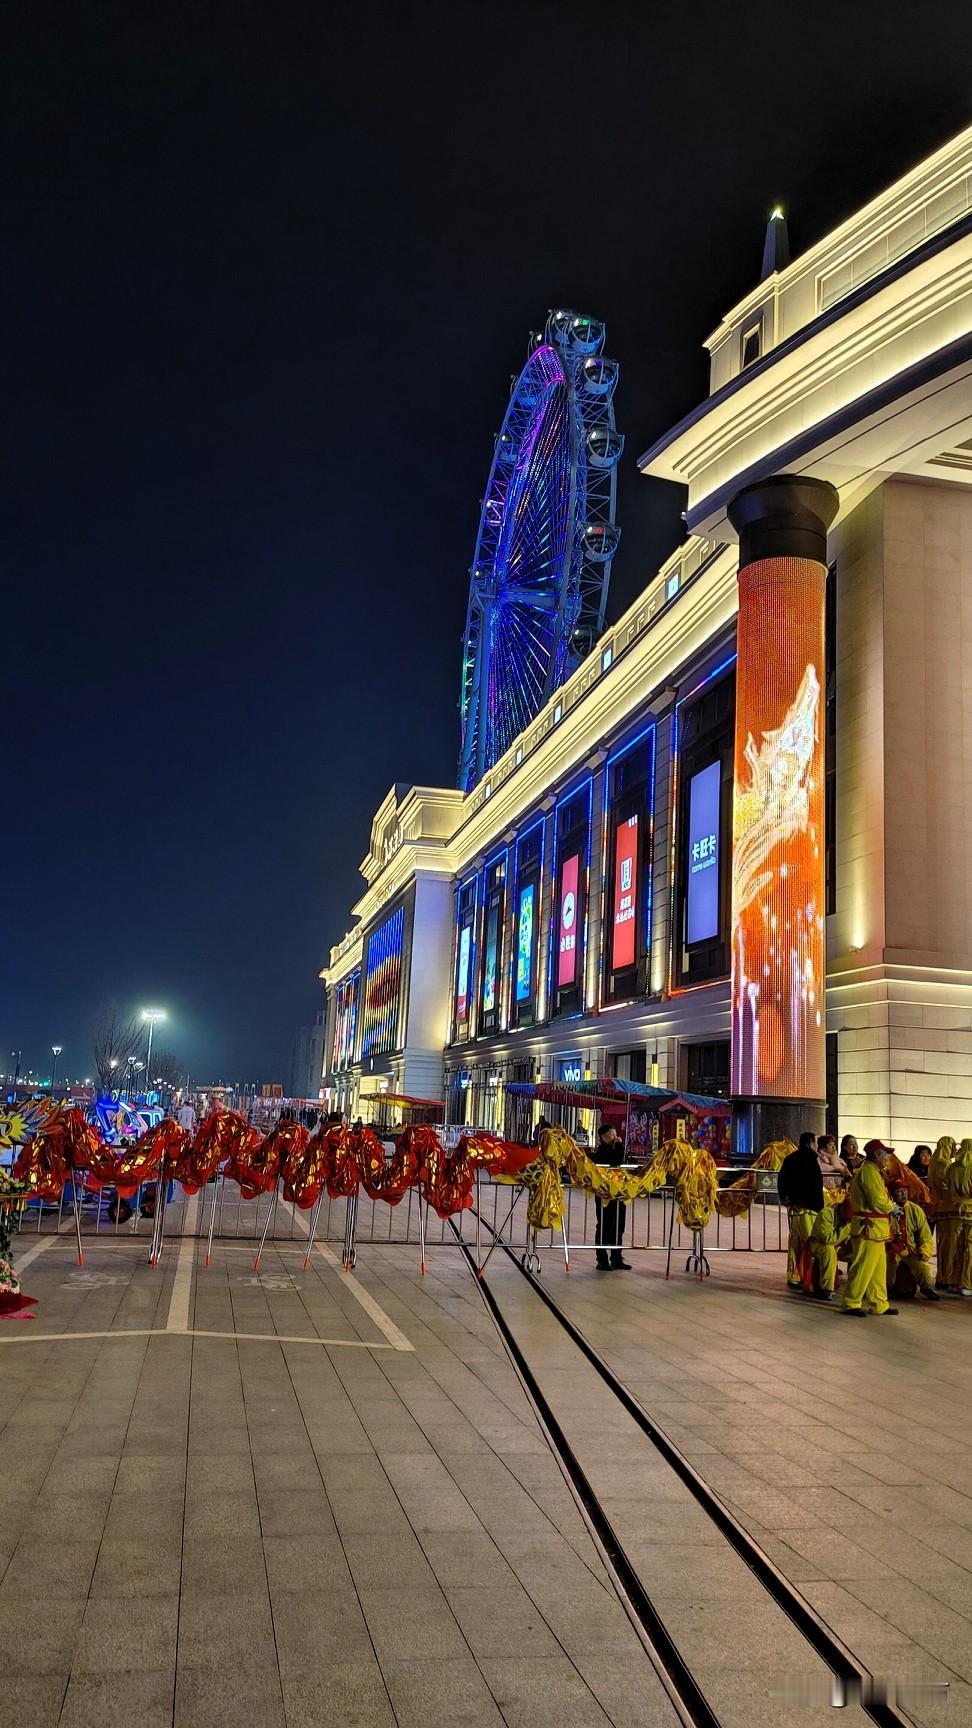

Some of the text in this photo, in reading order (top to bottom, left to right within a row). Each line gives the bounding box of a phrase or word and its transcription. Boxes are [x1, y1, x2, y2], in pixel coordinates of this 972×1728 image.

[692, 835, 716, 862] 卡旺卡
[565, 1065, 581, 1081] vivo
